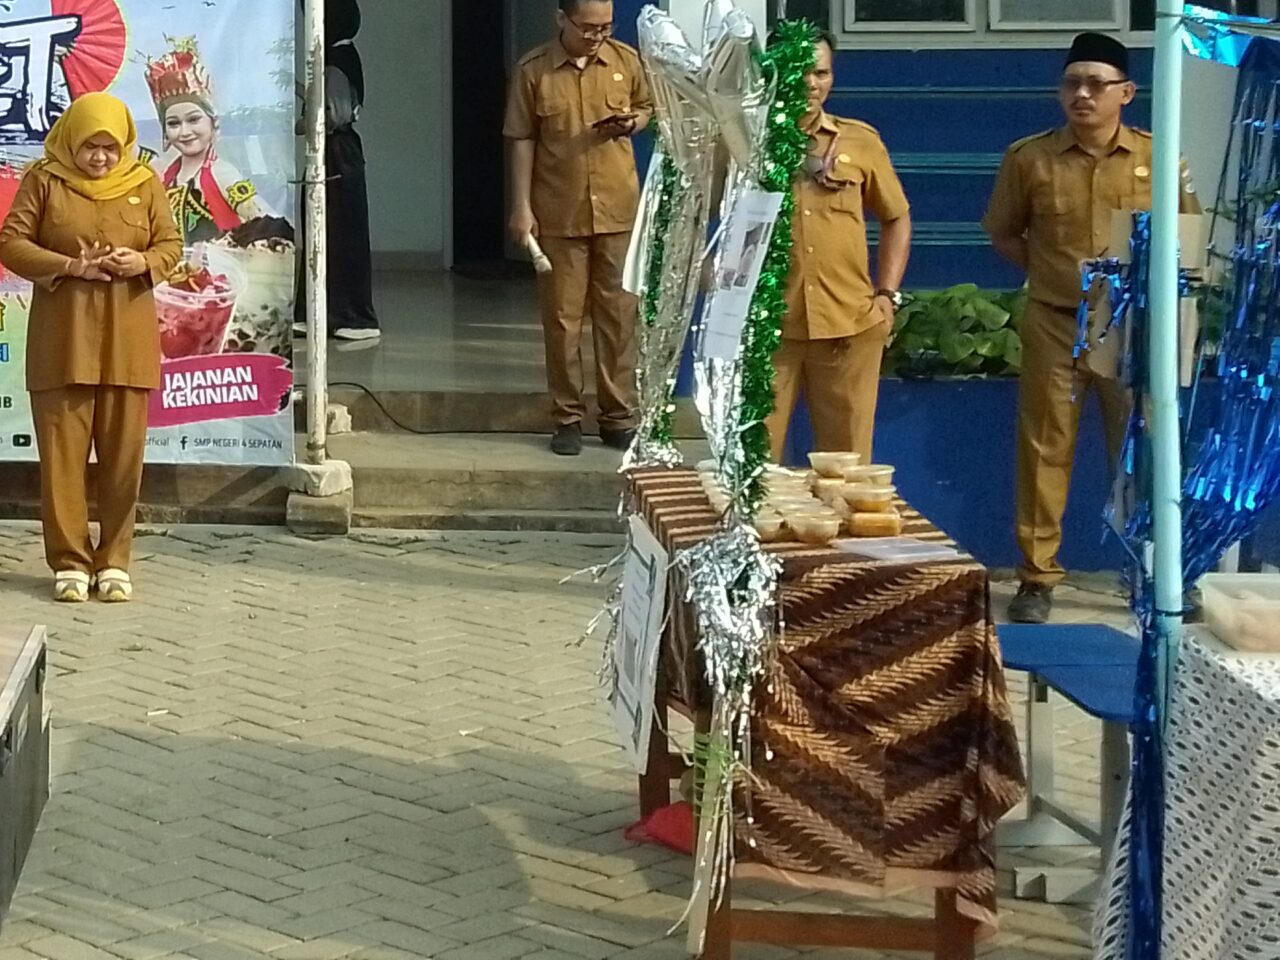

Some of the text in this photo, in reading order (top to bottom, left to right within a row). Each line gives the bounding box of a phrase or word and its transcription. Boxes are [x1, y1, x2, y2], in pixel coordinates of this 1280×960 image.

[164, 366, 252, 391] JAJANAN
[162, 385, 258, 409] KEKINIAN
[194, 438, 283, 449] SMP NEGERI 4 SEPATAN
